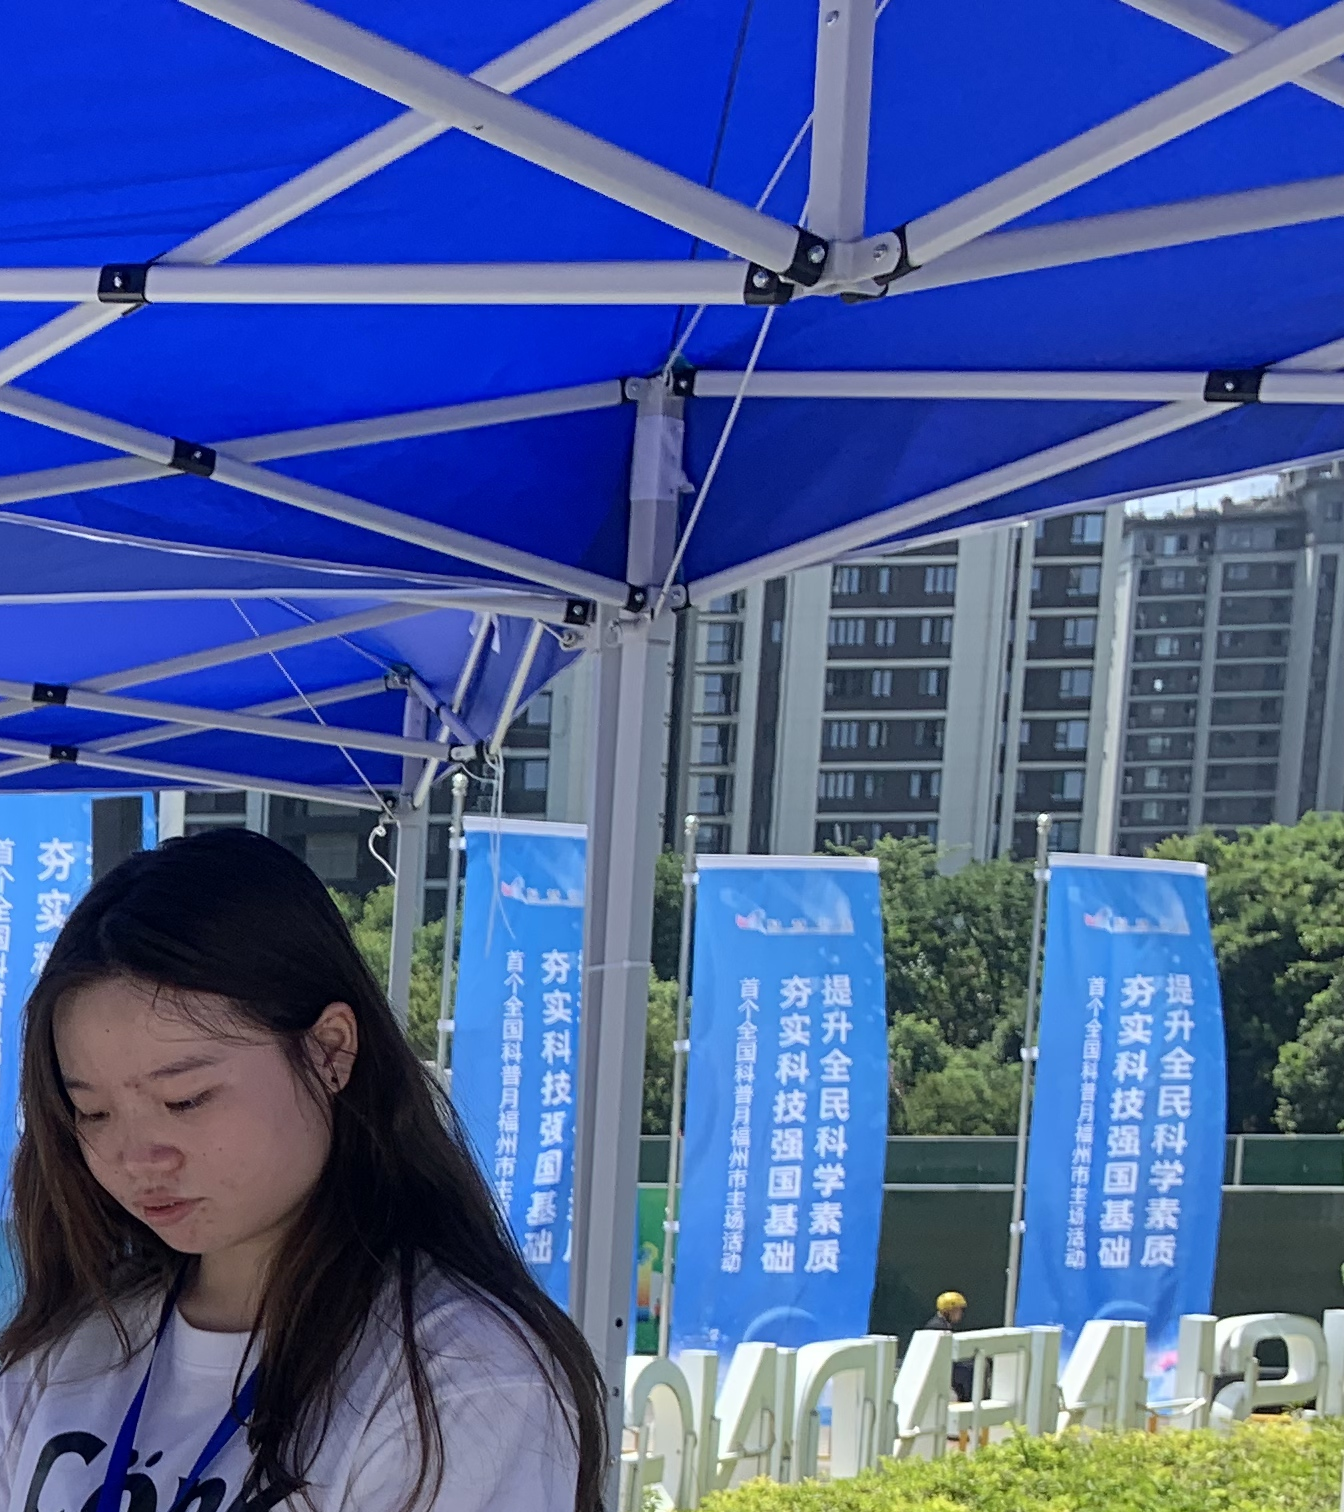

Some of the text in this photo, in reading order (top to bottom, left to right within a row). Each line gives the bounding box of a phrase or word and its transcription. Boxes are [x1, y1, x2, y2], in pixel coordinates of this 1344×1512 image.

[523, 949, 572, 1265] 夯实科技强国基础
[721, 977, 760, 1274] 首个全国科普月福州市主场活动
[761, 975, 813, 1274] 夯实科技强国基础
[804, 974, 853, 1274] 提升全民科学素质
[1065, 975, 1106, 1270] 首个全国科普月福州市主场活动
[1098, 974, 1156, 1269] 夯实科技强国基础
[1141, 973, 1196, 1268] 提升全民科学素质
